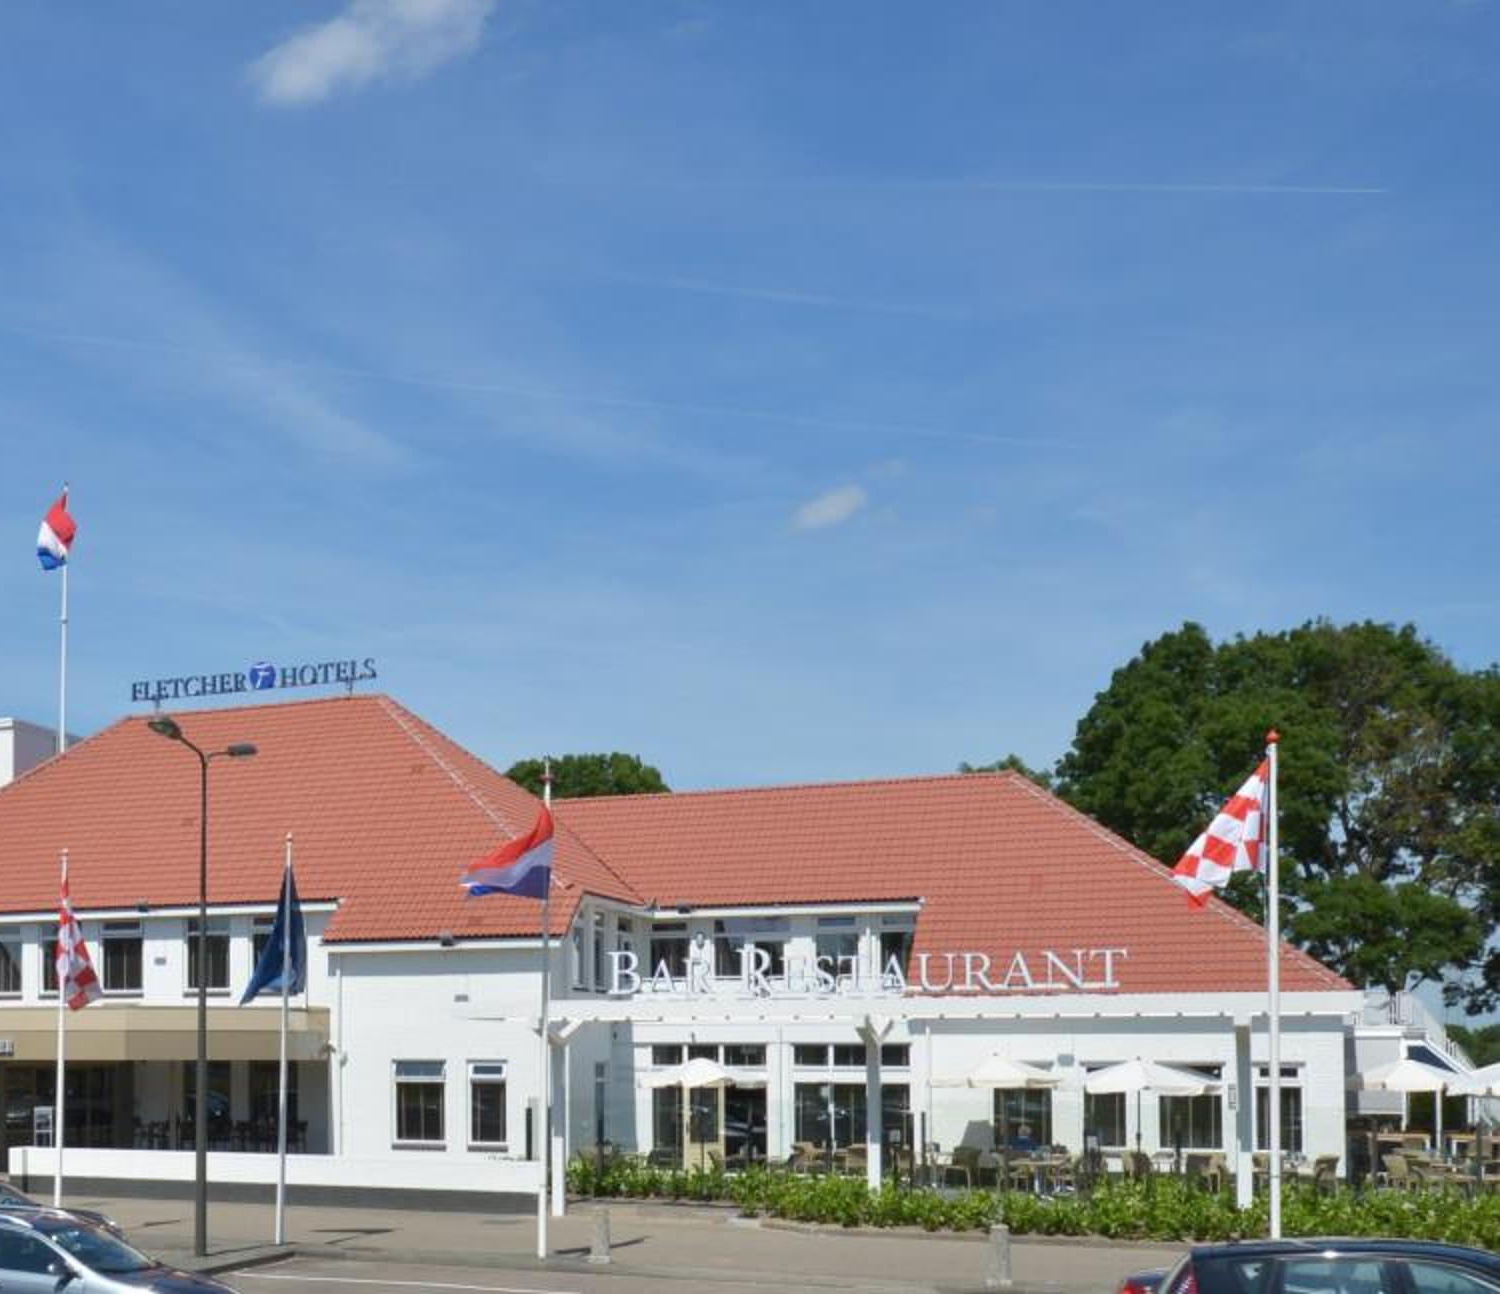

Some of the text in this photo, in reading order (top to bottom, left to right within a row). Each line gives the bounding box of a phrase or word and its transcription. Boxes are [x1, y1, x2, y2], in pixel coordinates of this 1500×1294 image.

[131, 673, 248, 702] FLETCHER
[280, 658, 378, 688] HOTELS
[605, 951, 710, 995] BAR
